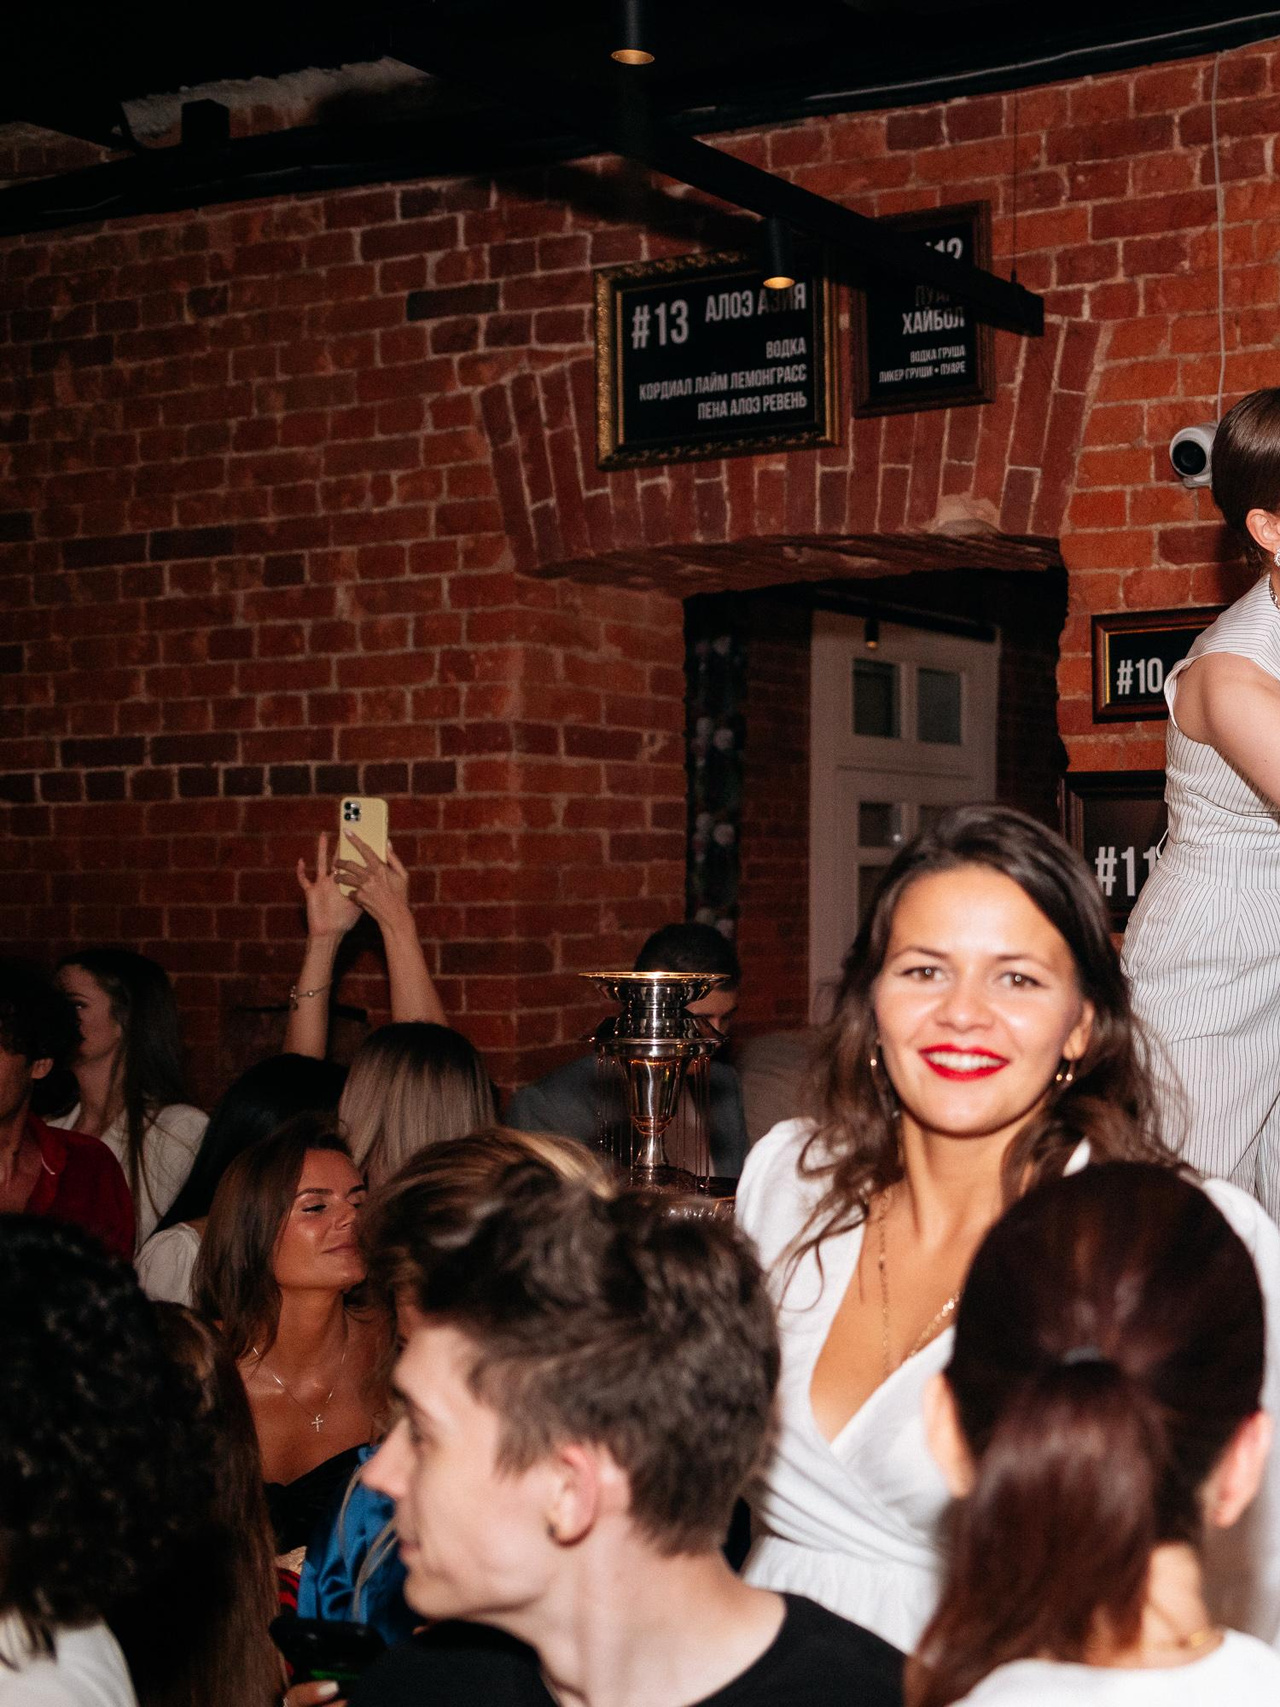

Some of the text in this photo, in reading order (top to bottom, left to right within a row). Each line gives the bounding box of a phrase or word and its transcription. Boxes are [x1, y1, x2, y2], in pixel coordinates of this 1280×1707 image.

[631, 298, 690, 350] #13
[704, 289, 754, 324] АЛОЭ
[765, 336, 808, 360] ВОДКА
[638, 363, 808, 401] КОРДИАЛ ЛАЙМ ЛЕМОНГРАСС
[696, 400, 729, 421] ПЕНА
[762, 390, 808, 413] РЕВЕНЬ
[1116, 656, 1163, 695] #10
